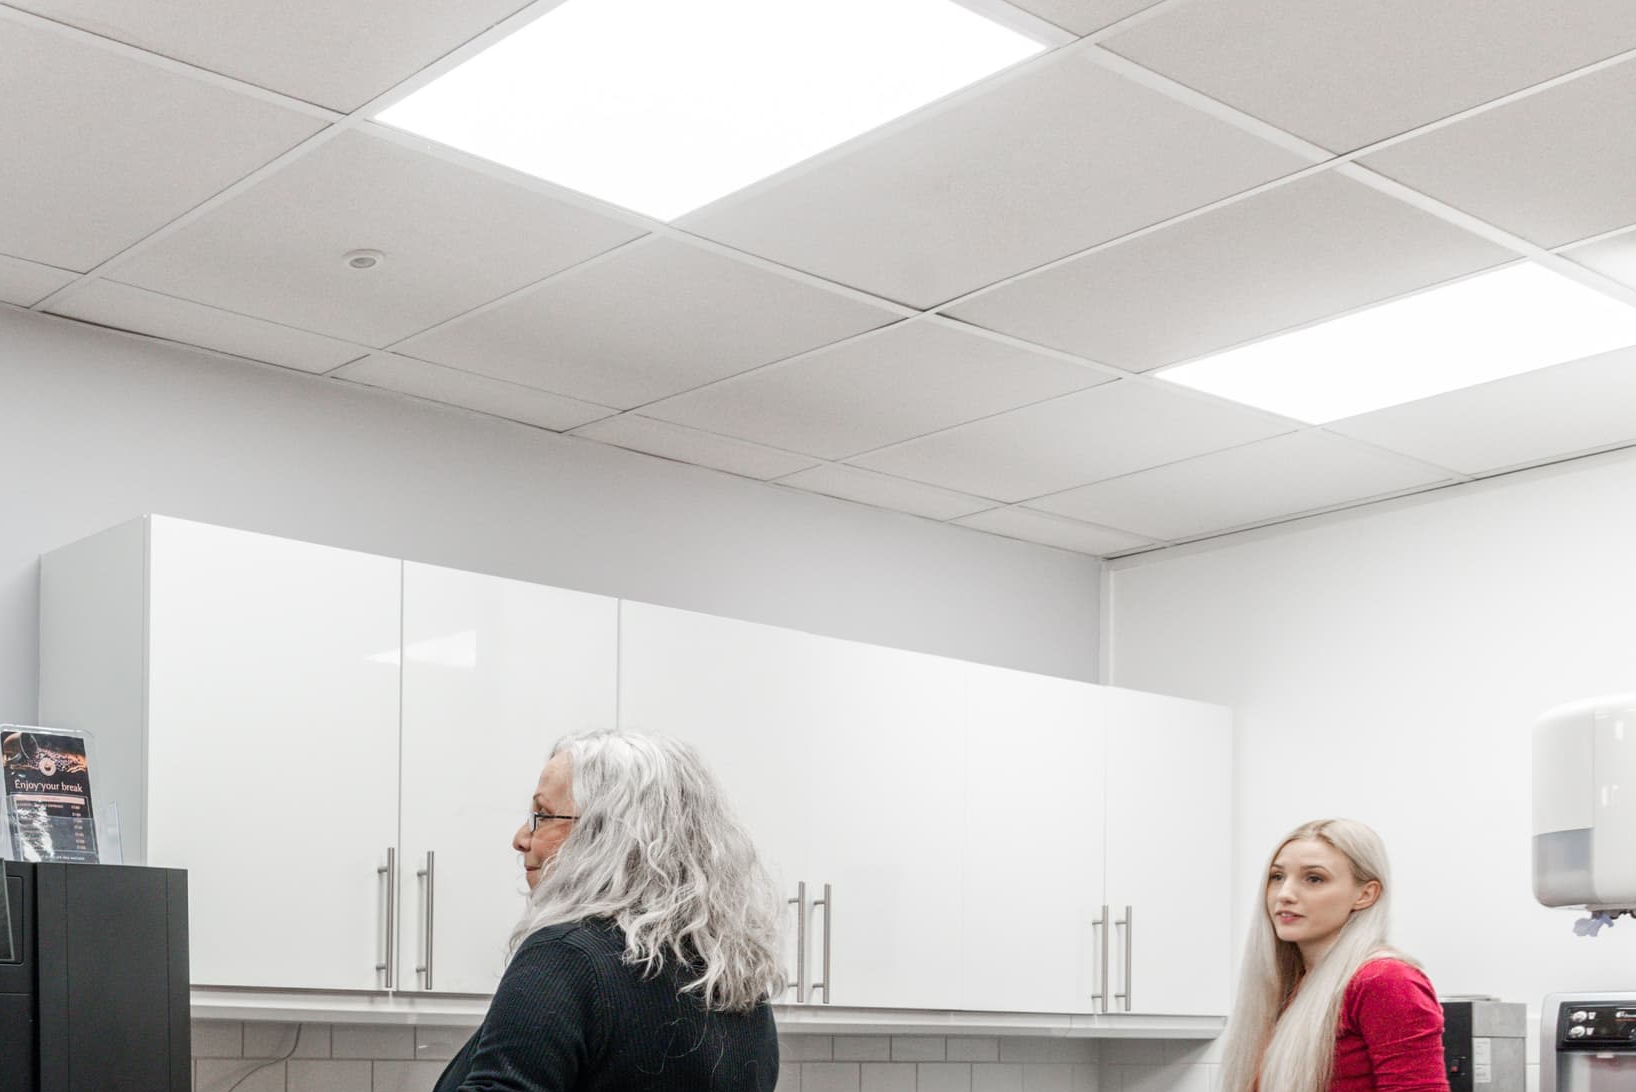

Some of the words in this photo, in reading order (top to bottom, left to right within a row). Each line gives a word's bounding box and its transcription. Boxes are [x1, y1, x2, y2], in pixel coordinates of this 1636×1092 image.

[14, 779, 39, 791] Enjoy
[41, 782, 59, 792] your
[61, 781, 83, 792] break
